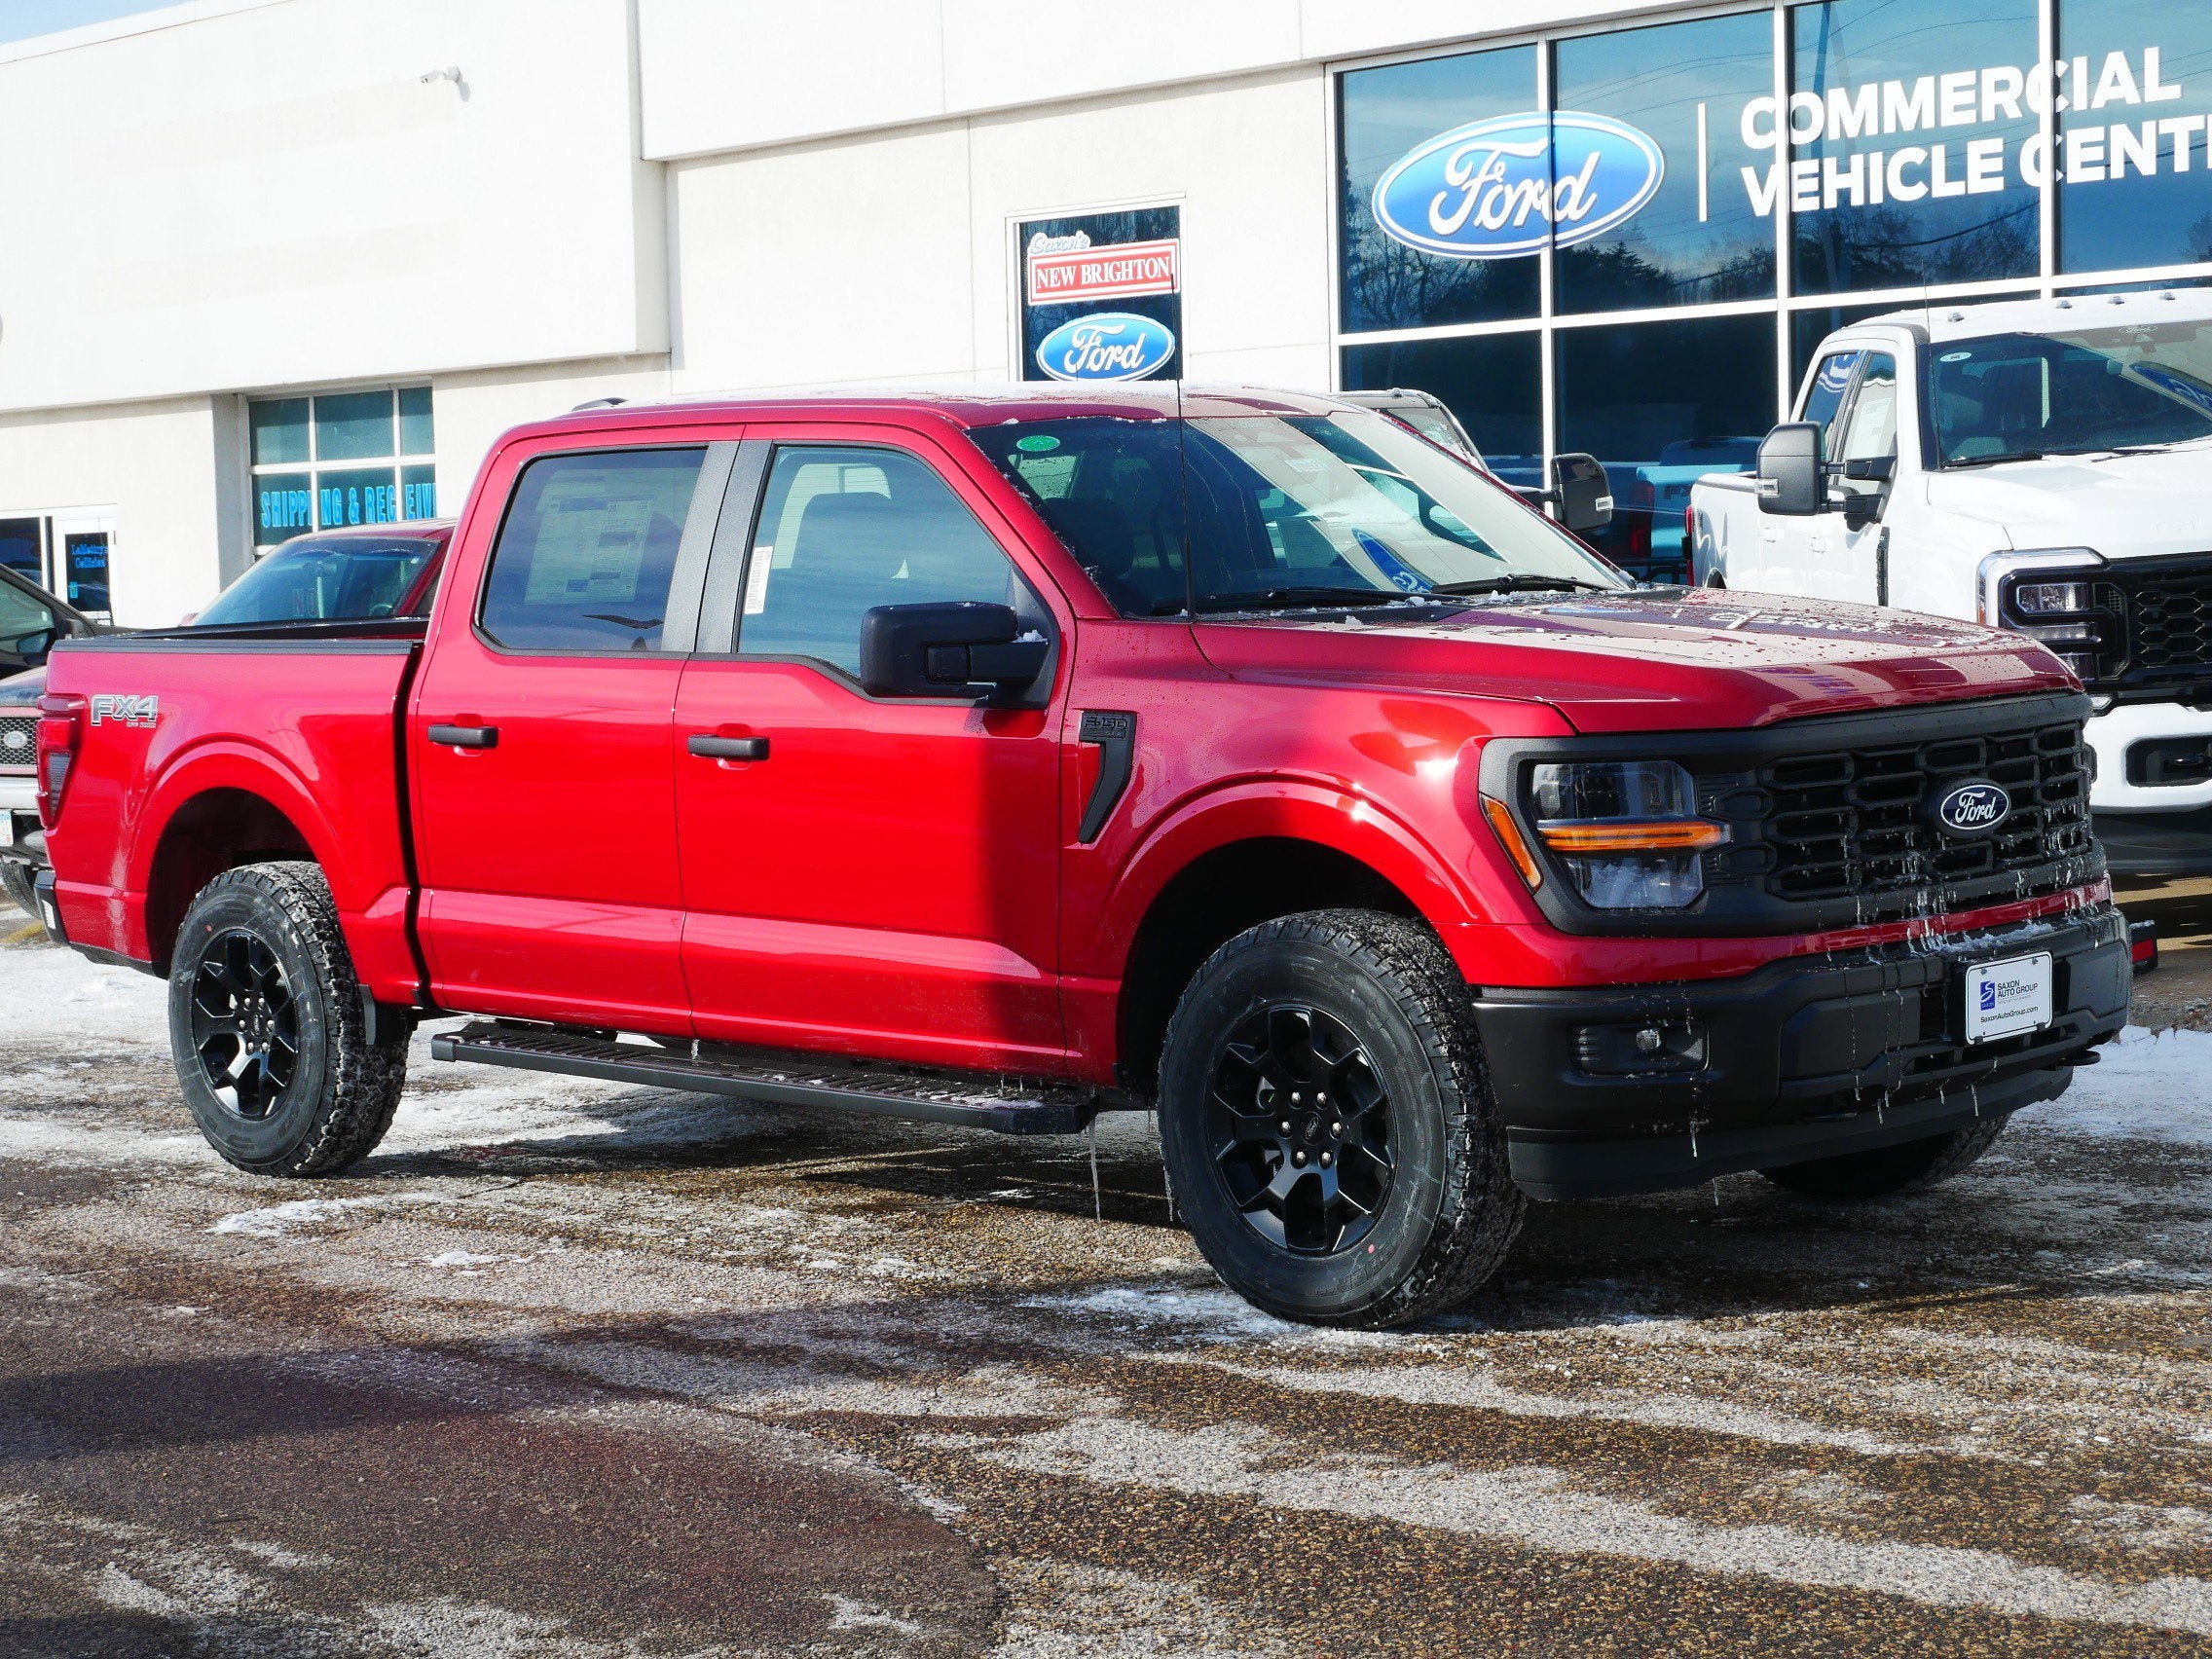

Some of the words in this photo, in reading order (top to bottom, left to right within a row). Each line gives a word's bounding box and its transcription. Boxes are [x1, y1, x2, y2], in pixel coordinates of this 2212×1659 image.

[1740, 47, 2183, 150] COMMERCIAL
[1741, 137, 2005, 217] VEHICLE
[2019, 114, 2212, 188] CENT
[1428, 135, 1602, 236] Ford
[1029, 232, 1089, 254] Saxon's
[1036, 263, 1077, 289] NEW
[1081, 256, 1171, 285] BRIGHTON
[1064, 323, 1147, 374] Ford
[261, 488, 343, 528] SHIPPING
[349, 487, 360, 525] &
[91, 694, 159, 726] FX4
[1955, 792, 1996, 824] Ford
[1997, 979, 2020, 991] SAXON
[1997, 988, 2015, 998] AUTO
[2015, 982, 2038, 994] GROUP
[1980, 1006, 2039, 1023] SaxonAutoGroup.com
